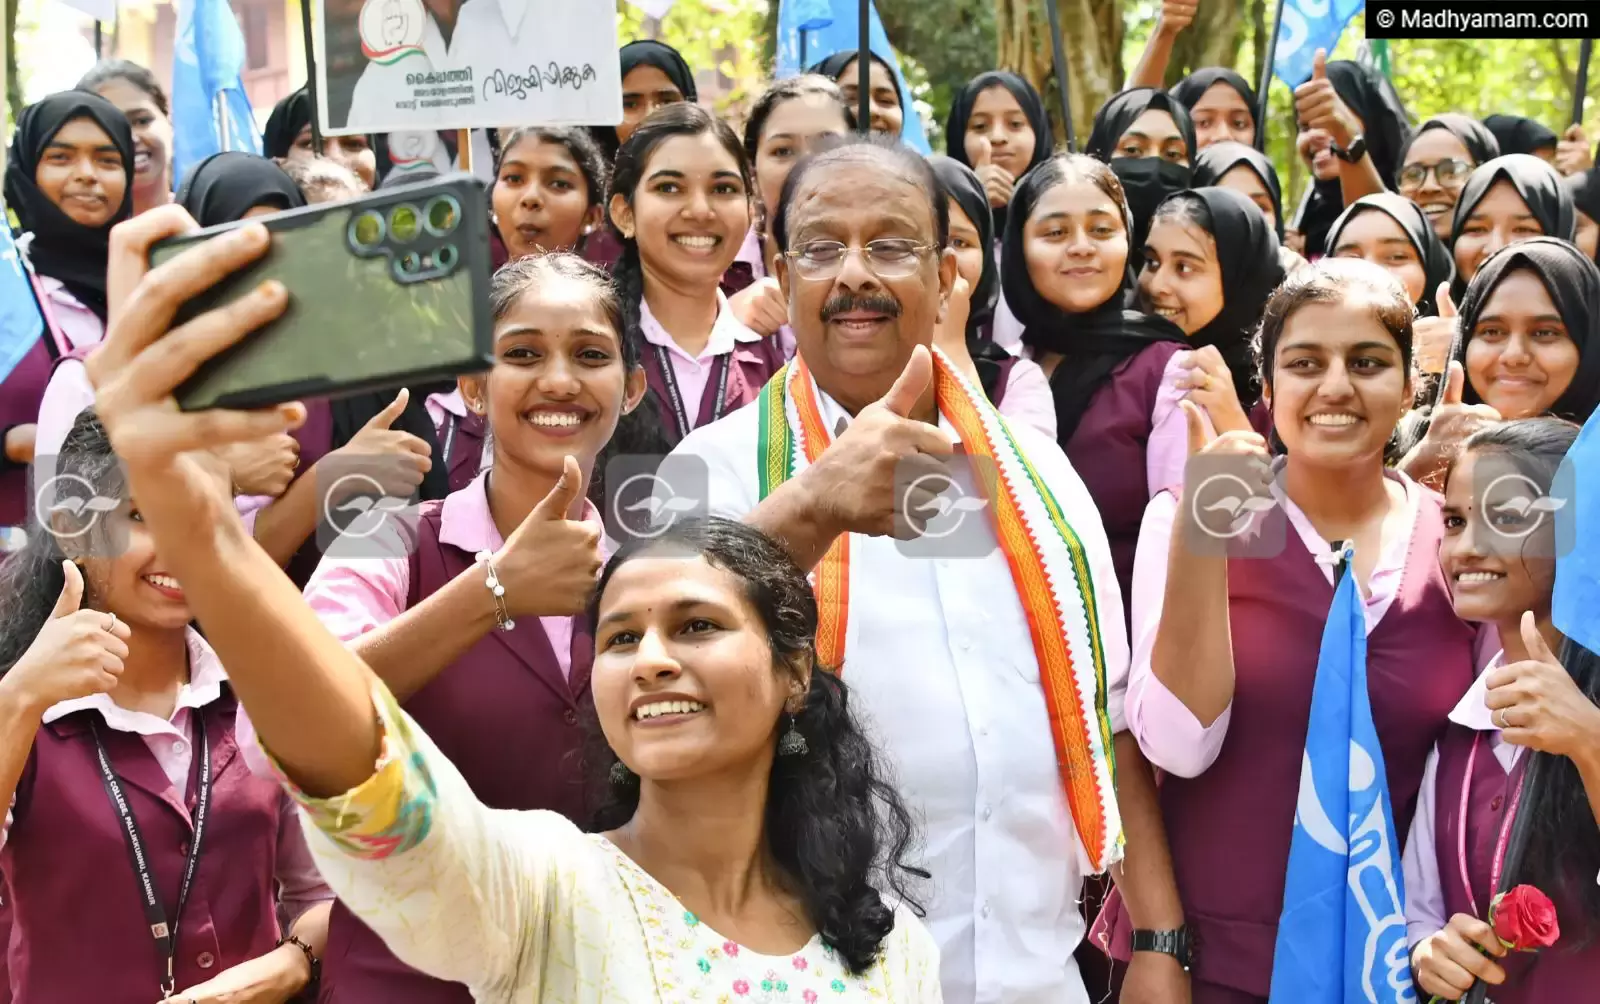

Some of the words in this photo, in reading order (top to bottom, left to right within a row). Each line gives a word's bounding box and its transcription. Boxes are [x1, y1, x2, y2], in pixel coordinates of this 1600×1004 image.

[110, 780, 128, 816] COLLEGE,
[124, 816, 147, 873] PALLIKKUNNU,
[141, 872, 156, 906] KANNUR
